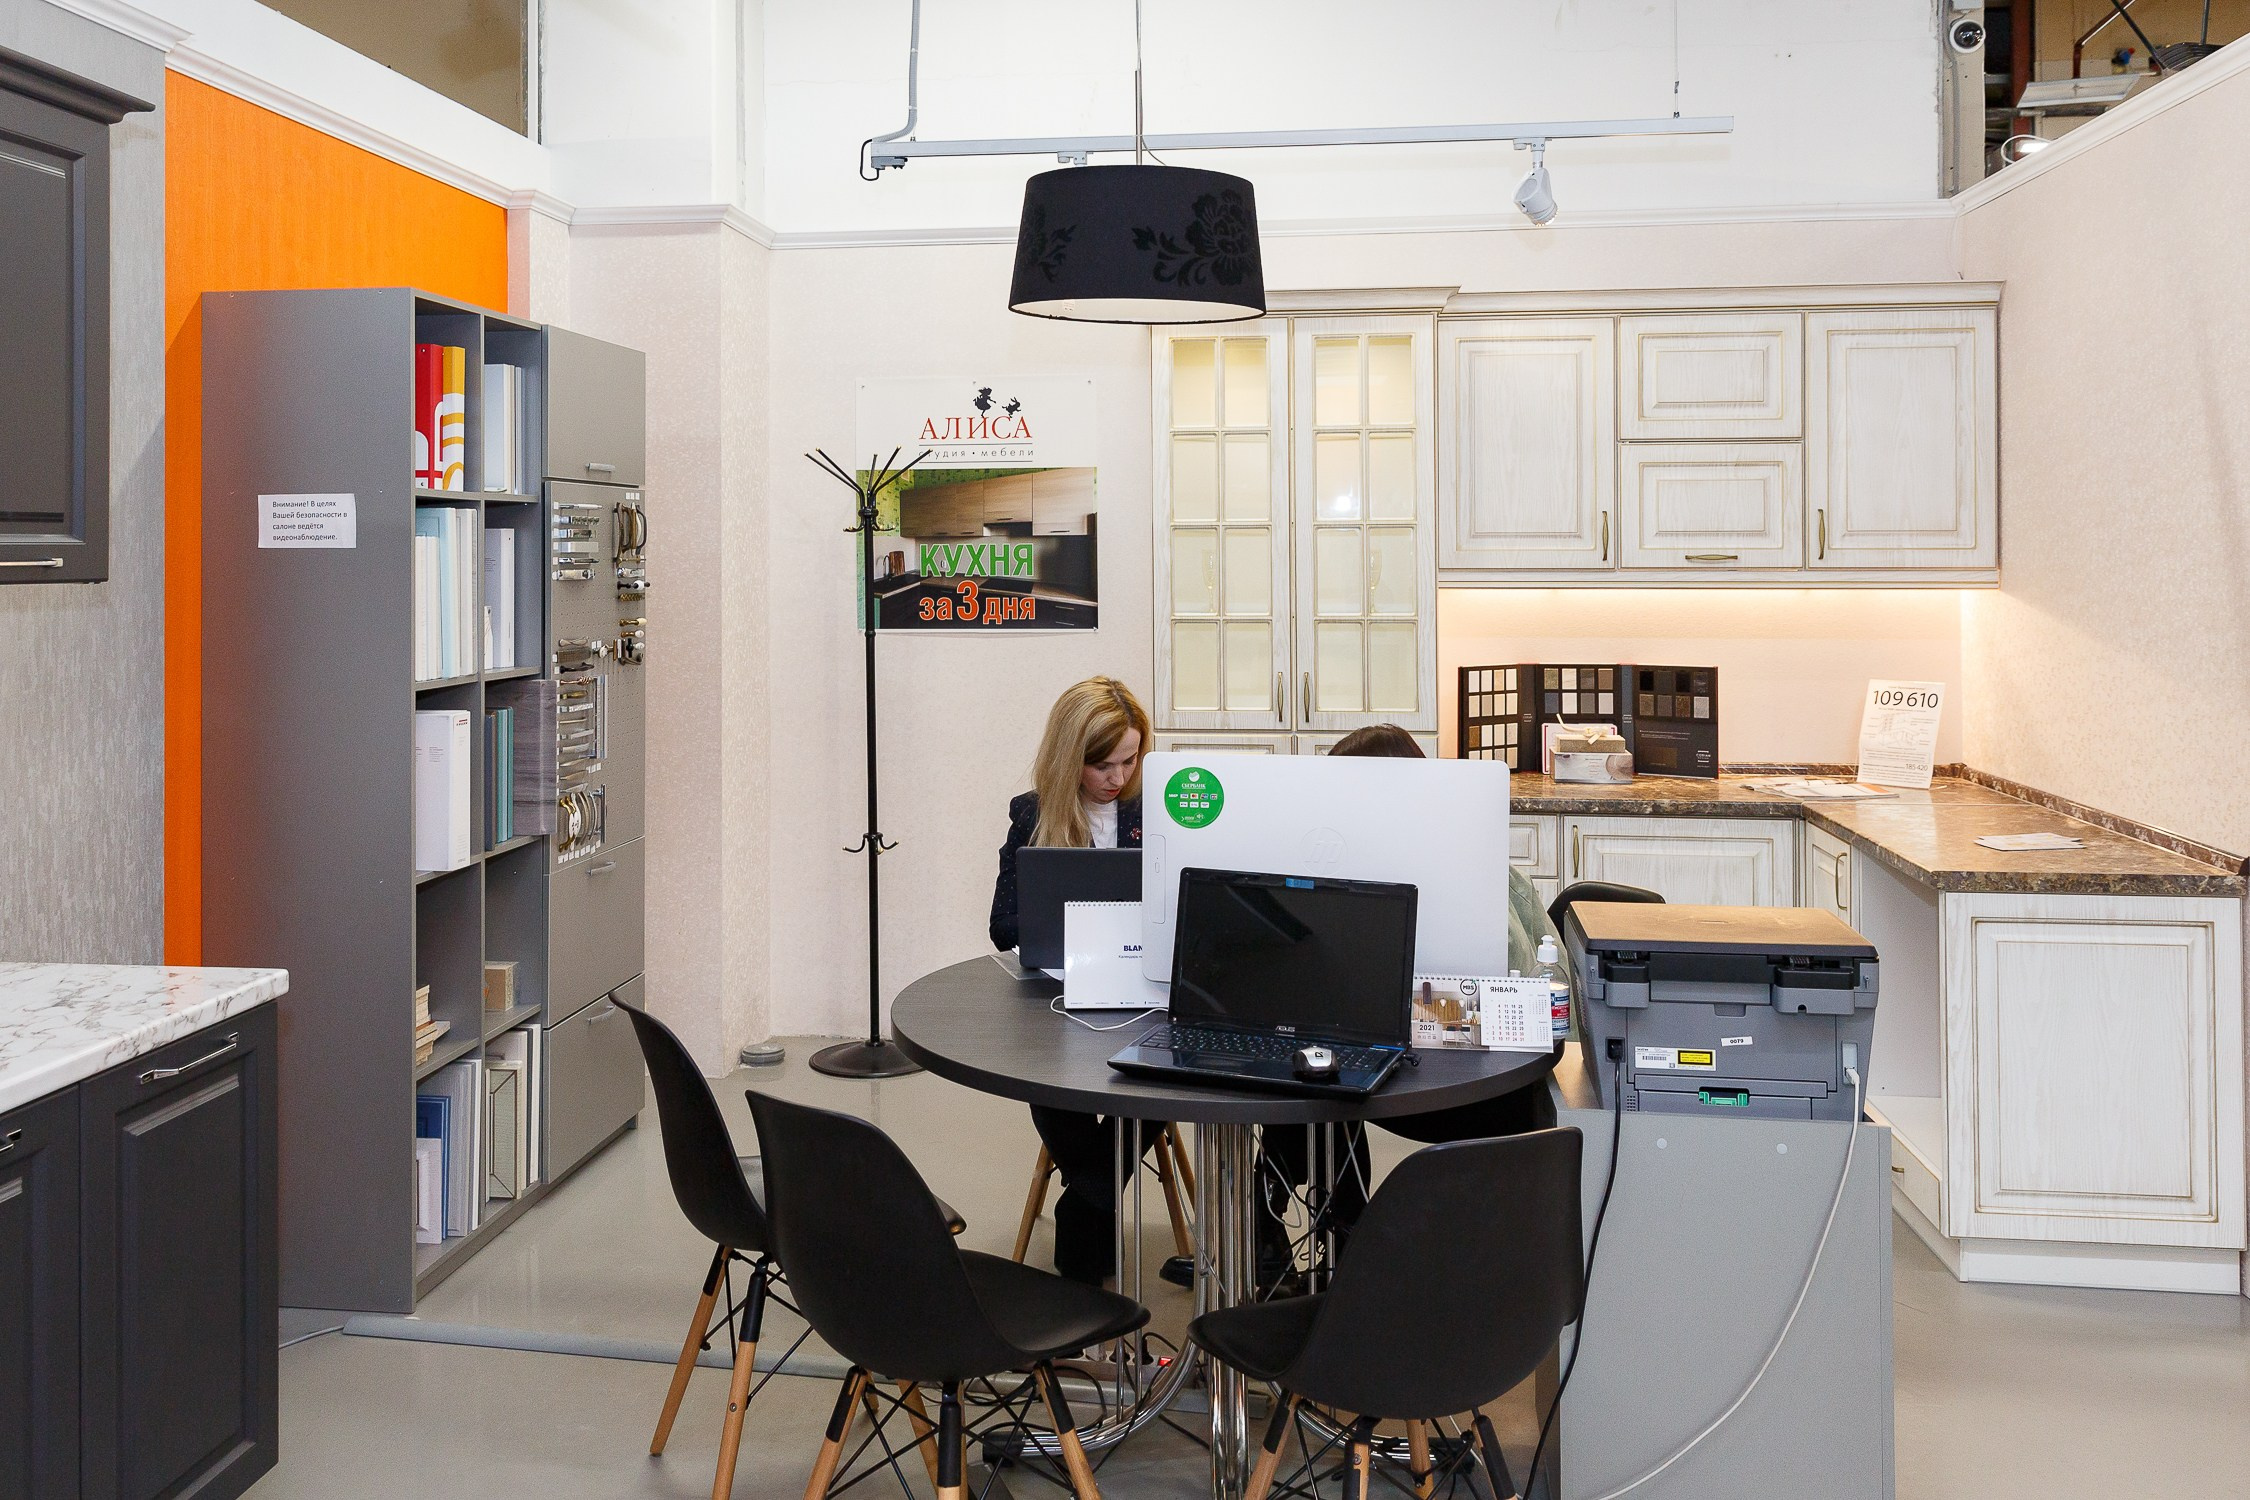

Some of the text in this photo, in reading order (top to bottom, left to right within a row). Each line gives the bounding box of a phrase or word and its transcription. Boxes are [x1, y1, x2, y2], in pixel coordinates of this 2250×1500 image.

[919, 416, 1032, 440] АЛИСА
[981, 447, 1034, 457] мебели
[919, 543, 1034, 577] КУХНЯ
[919, 579, 1036, 625] за 3 дня
[1873, 690, 1939, 709] 109 610
[1489, 986, 1518, 994] ЯНВАРЬ
